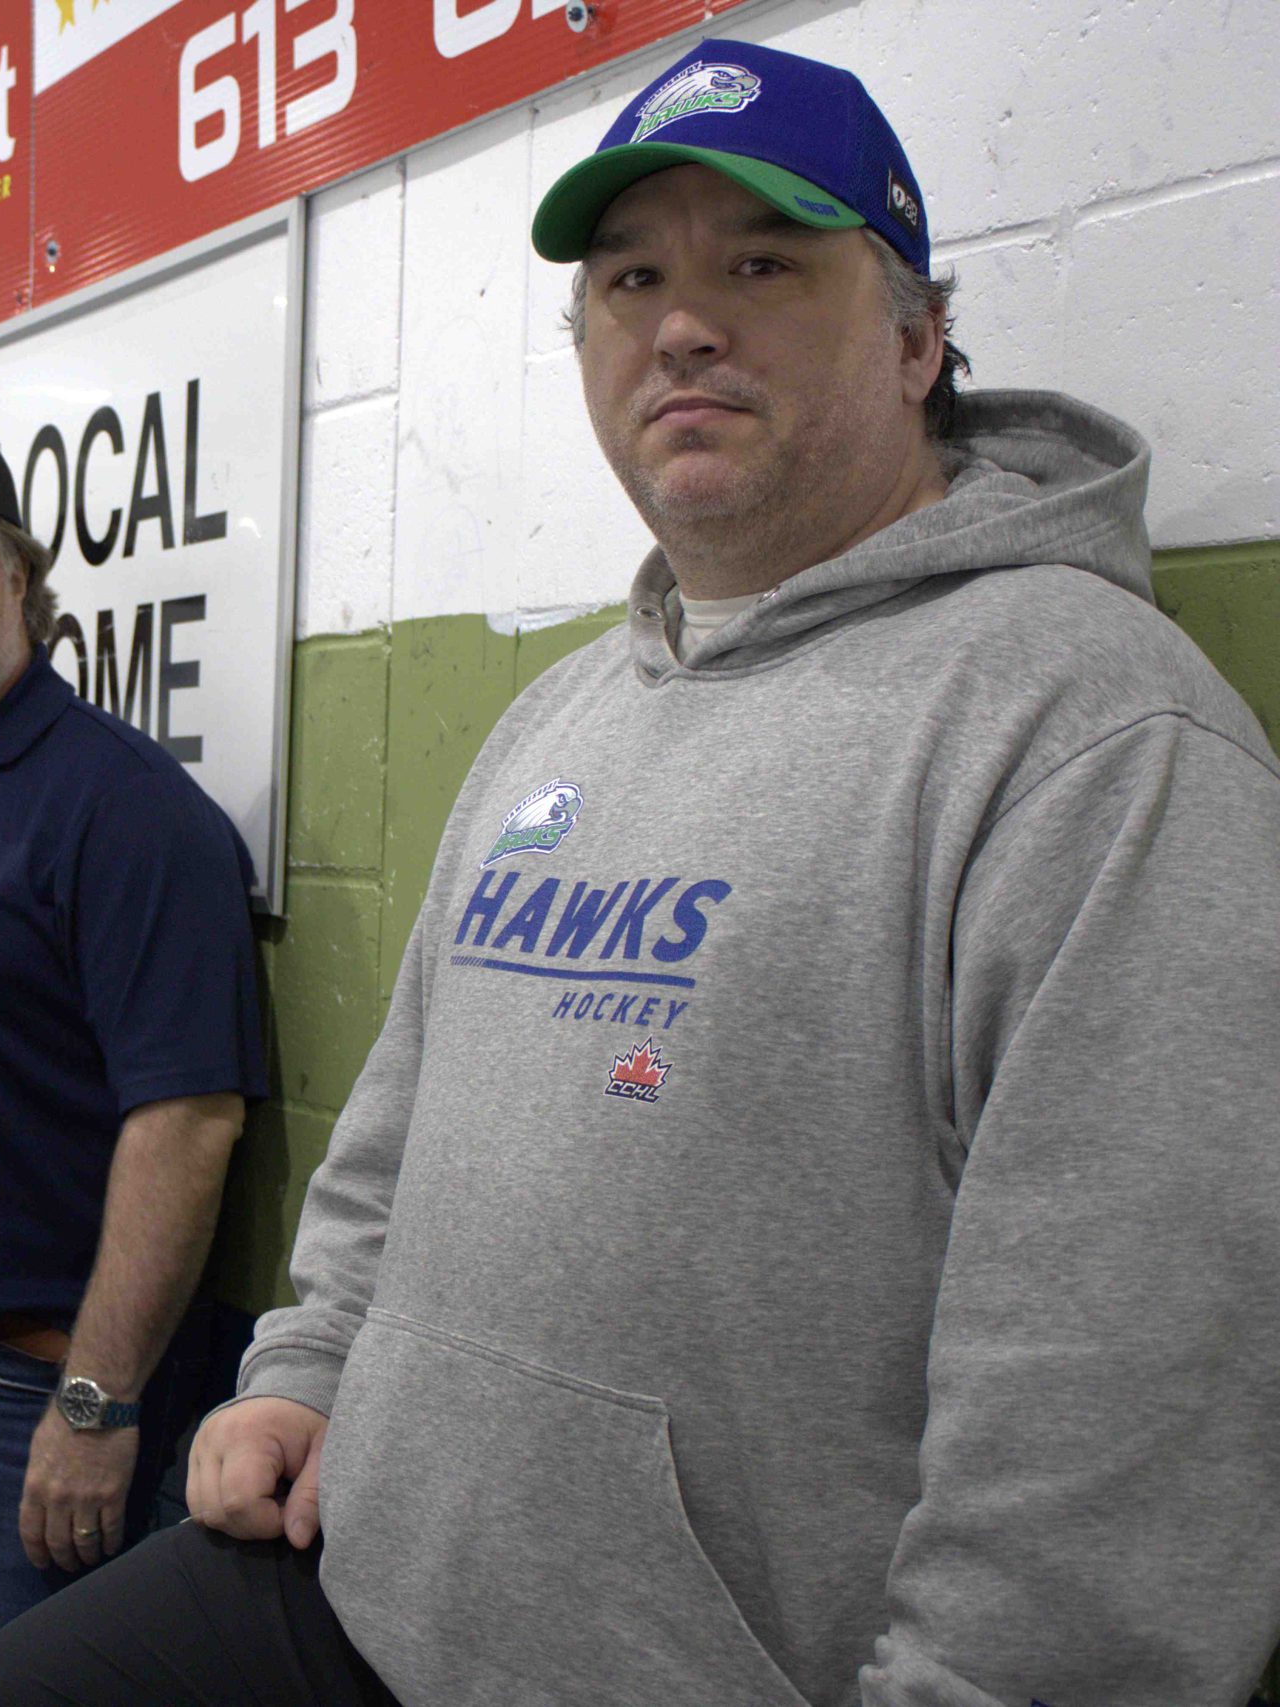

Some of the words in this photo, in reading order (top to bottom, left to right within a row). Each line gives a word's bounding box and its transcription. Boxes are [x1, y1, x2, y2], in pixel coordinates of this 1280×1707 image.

[631, 90, 750, 143] HAWKS
[22, 378, 228, 573] OCAL
[48, 594, 207, 763] OME
[454, 870, 733, 963] HAWKS
[552, 991, 689, 1030] HOCKEY
[607, 1080, 656, 1100] CCHL
